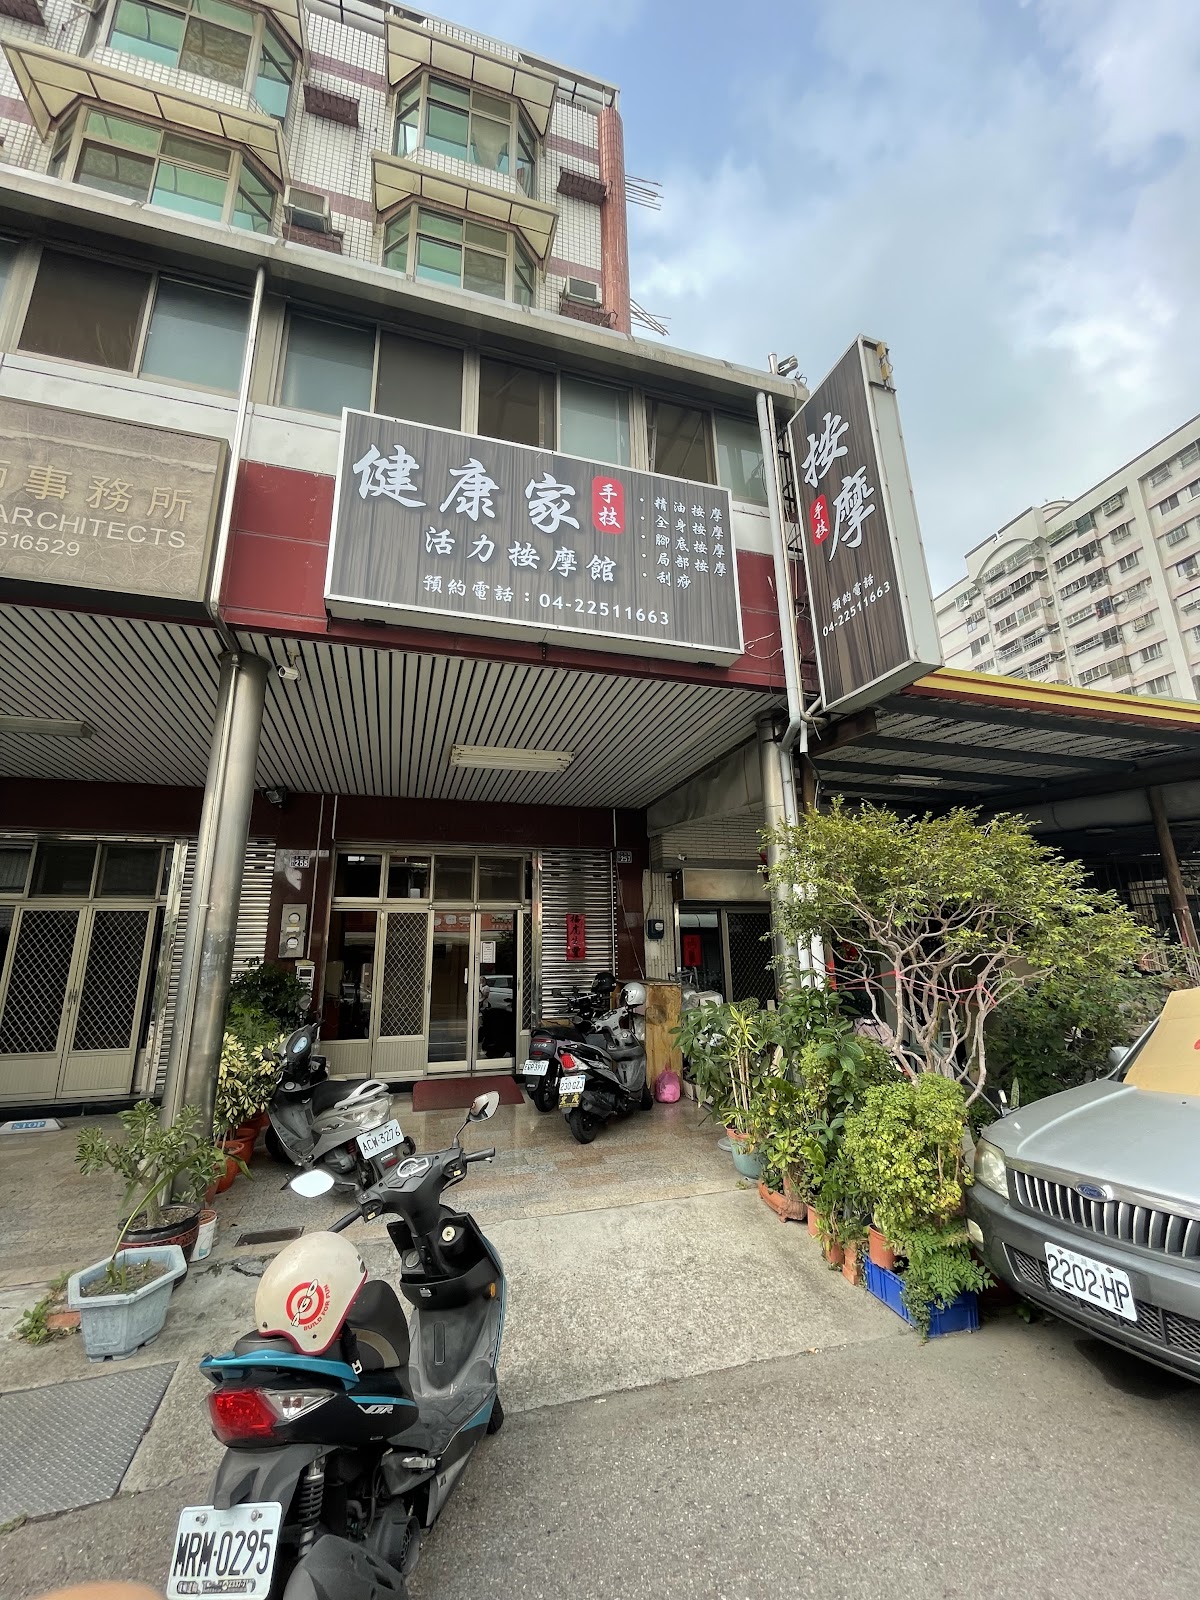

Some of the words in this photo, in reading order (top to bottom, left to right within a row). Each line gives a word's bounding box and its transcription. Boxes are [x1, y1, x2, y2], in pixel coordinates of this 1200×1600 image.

[0, 460, 192, 522] 事務所
[353, 444, 580, 534] 健康家
[598, 483, 622, 530] 手技
[802, 412, 876, 562] 按摩
[654, 496, 723, 522] 精油按摩
[655, 514, 724, 540] 全身按摩
[813, 502, 828, 540] 手技
[425, 526, 617, 582] 活力按摩館
[655, 533, 725, 559] 腳底按摩
[656, 552, 727, 577] 局部按摩
[656, 571, 692, 590] 刮痧
[832, 573, 874, 613] 預約電話
[539, 593, 670, 627] 04-22511663
[822, 581, 890, 637] 04-22511663
[362, 1126, 401, 1153] ACW-3276
[1048, 1253, 1130, 1309] 2202-HP
[304, 1317, 322, 1331] BUILD
[321, 1301, 330, 1316] FOR
[173, 1529, 274, 1577] MRM-0295
